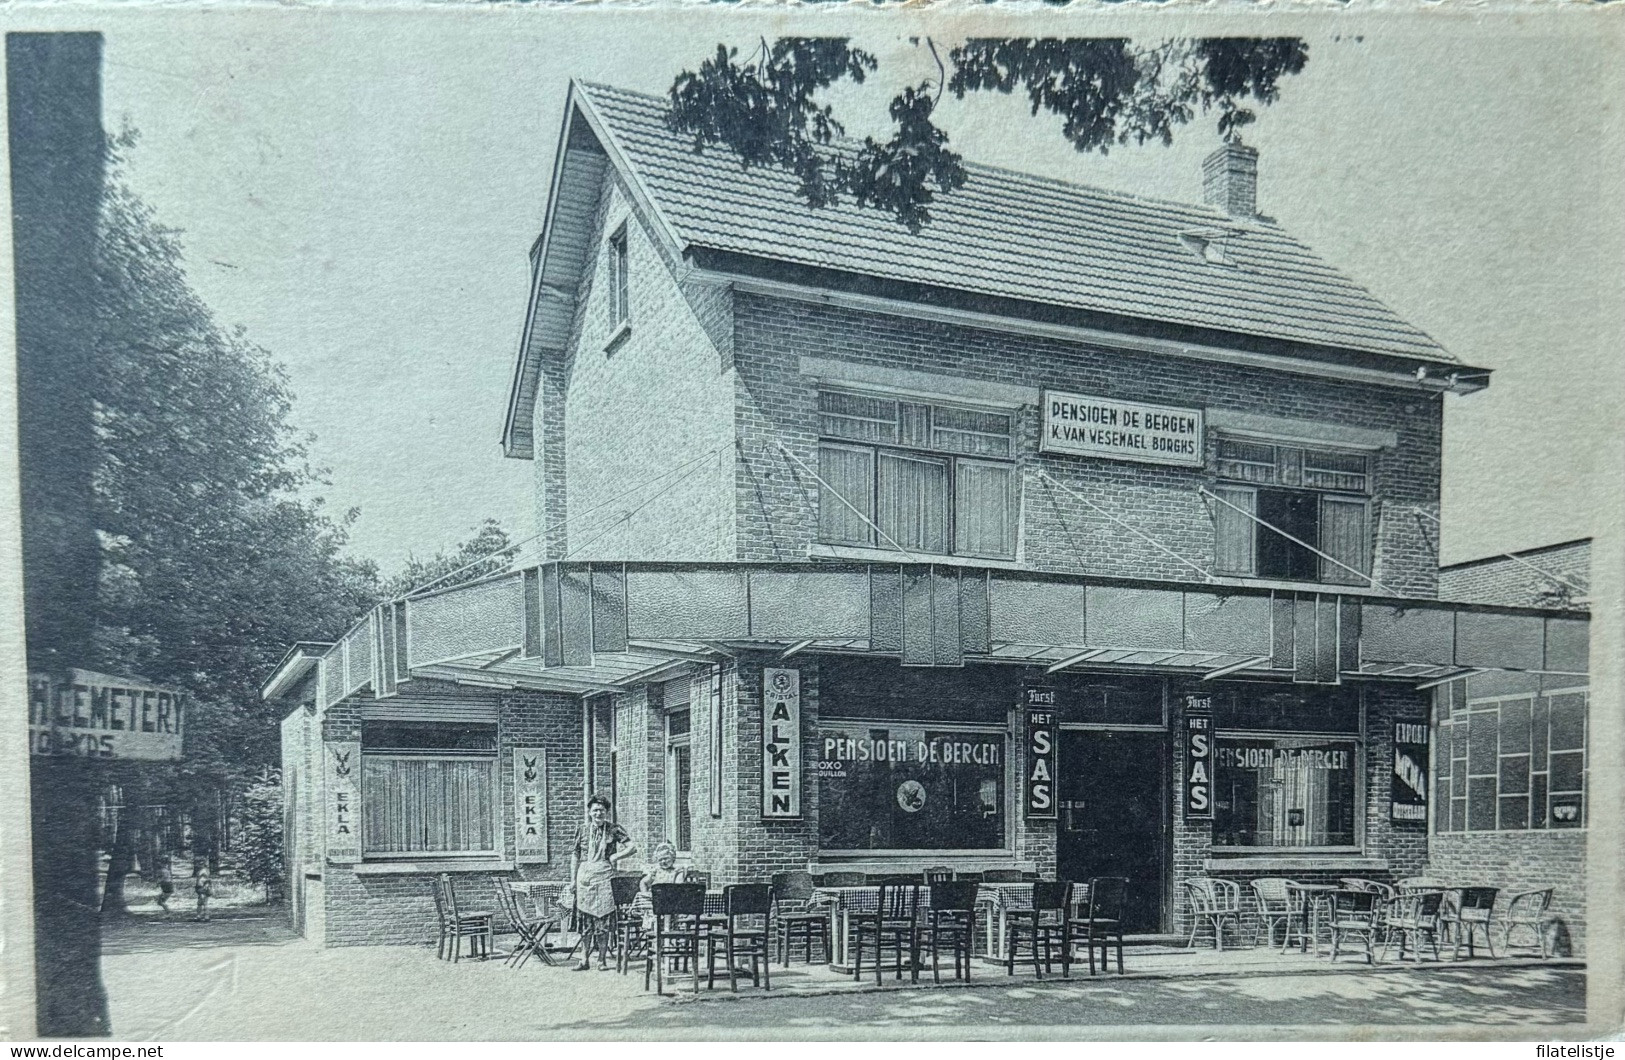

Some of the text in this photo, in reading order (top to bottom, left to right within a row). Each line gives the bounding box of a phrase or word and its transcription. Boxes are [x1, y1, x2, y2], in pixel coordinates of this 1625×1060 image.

[1052, 402, 1195, 434] PENSIOEN DE BERGEN
[1063, 426, 1085, 442] VAN
[1089, 429, 1147, 449] WESEMAEL
[1152, 437, 1195, 454] BORGHS
[53, 683, 187, 735] CEMETERY
[765, 689, 798, 701] CRISTAL
[1031, 714, 1051, 725] HET
[1189, 718, 1208, 729] HET
[1395, 723, 1427, 744] EXPORT
[71, 733, 115, 757] YDS
[771, 702, 790, 814] ALKEN
[824, 738, 1000, 765] PENSIOEN DE BERGEN
[818, 761, 842, 770] OXO
[1030, 730, 1051, 809] SAS
[1189, 734, 1208, 810] SAS
[337, 792, 351, 834] EKLA
[525, 795, 537, 835] EKLA
